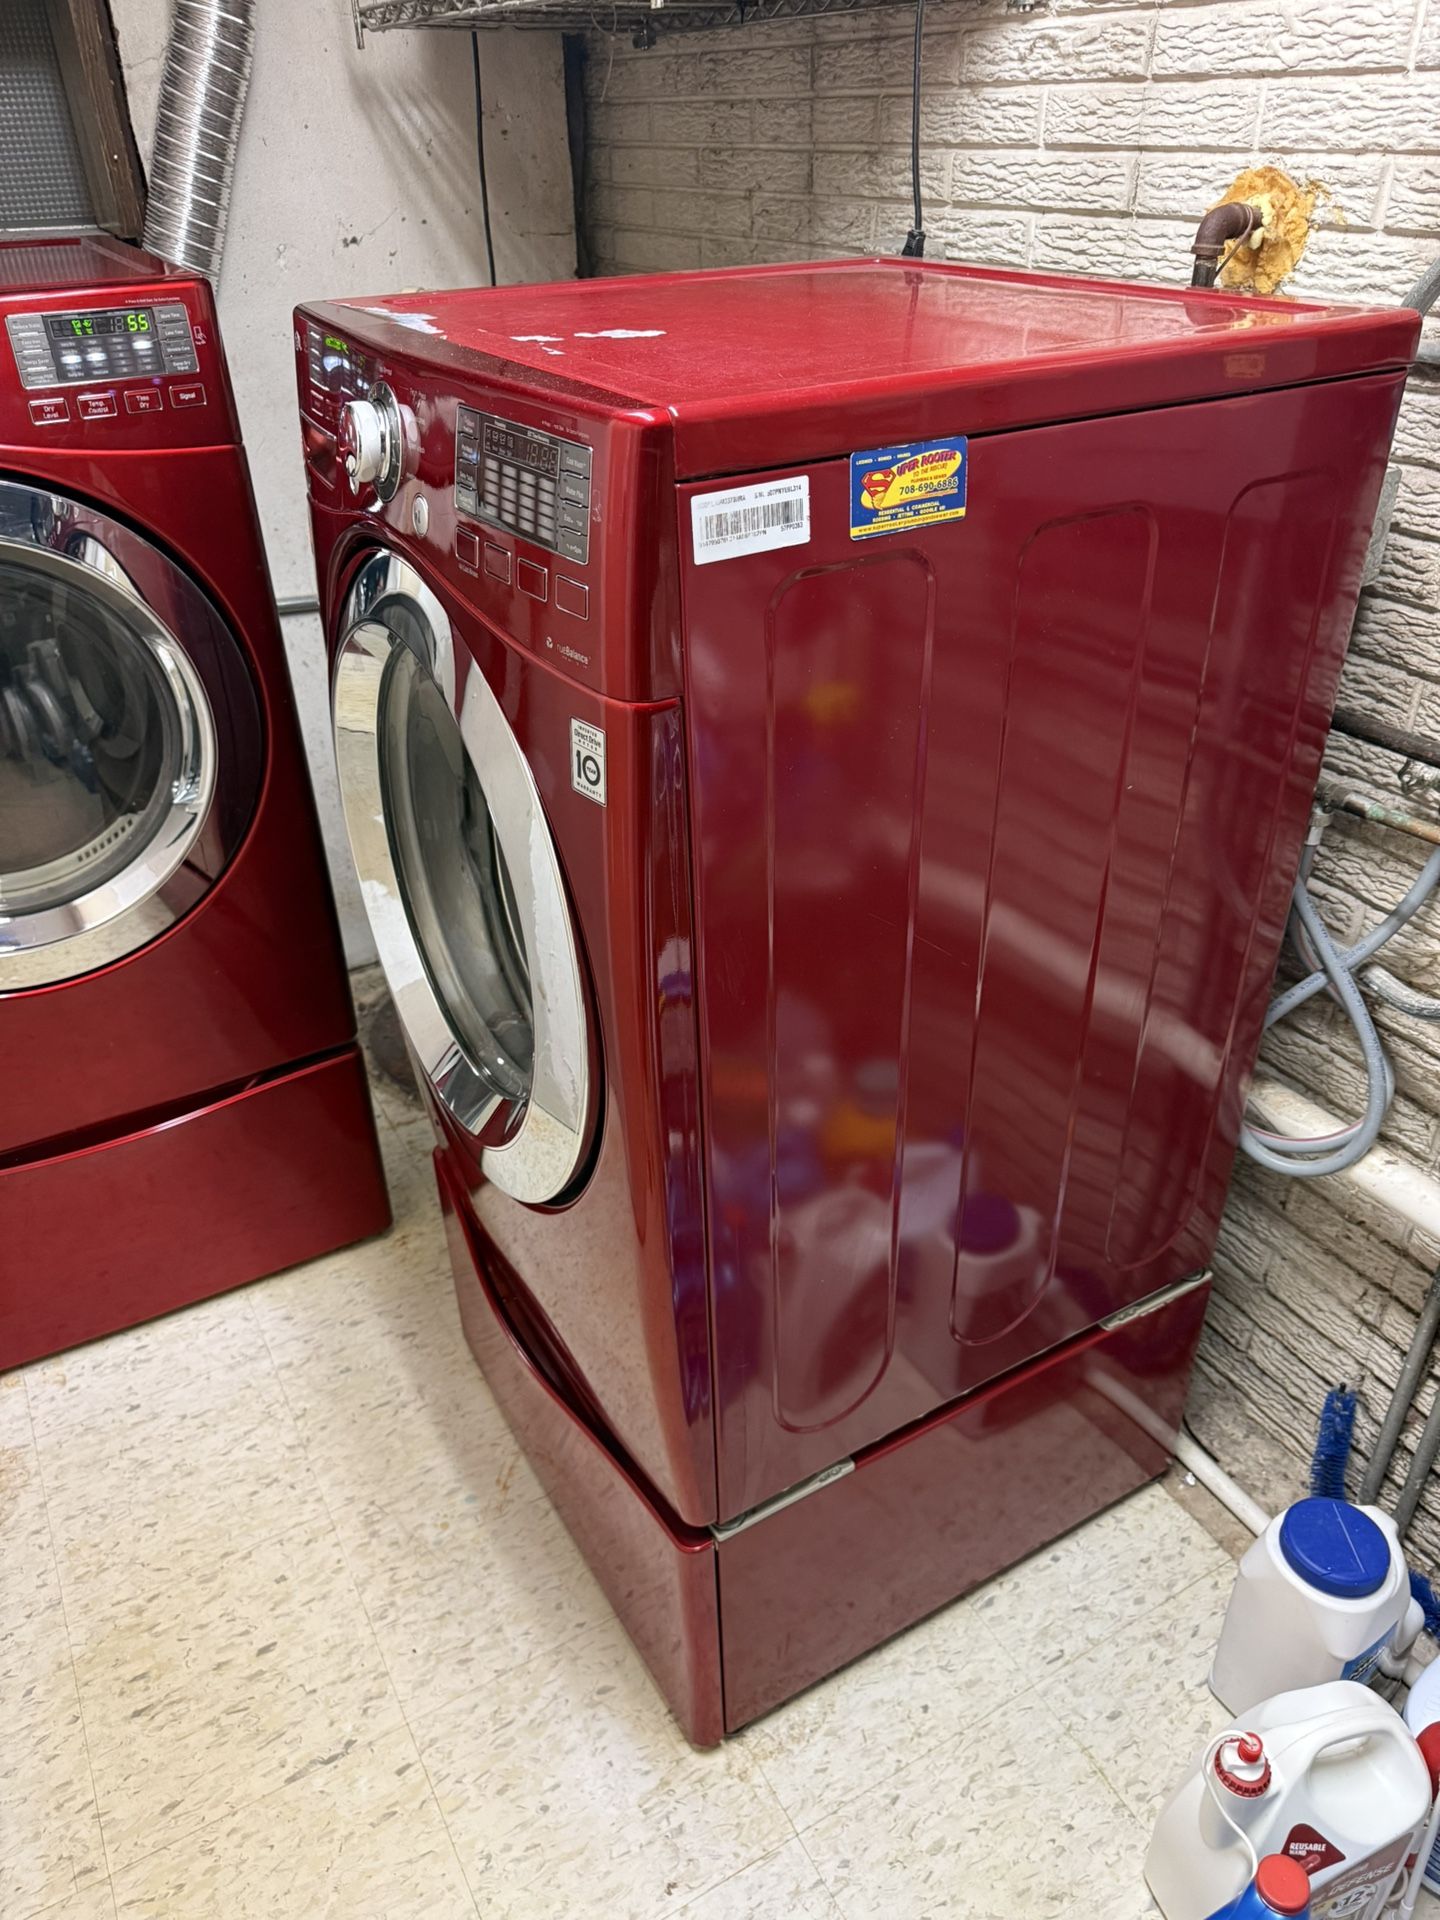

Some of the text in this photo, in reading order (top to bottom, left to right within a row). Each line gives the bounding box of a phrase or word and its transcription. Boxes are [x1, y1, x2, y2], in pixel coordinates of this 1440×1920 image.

[127, 314, 149, 331] 55
[179, 392, 196, 400] Signal
[921, 450, 957, 467] ROOTER
[899, 477, 959, 496] 708-690-6886
[576, 749, 602, 786] 10
[576, 781, 602, 799] WARRANTY
[1289, 1842, 1326, 1852] REUSABLE
[1328, 1862, 1395, 1897] DEFENSE
